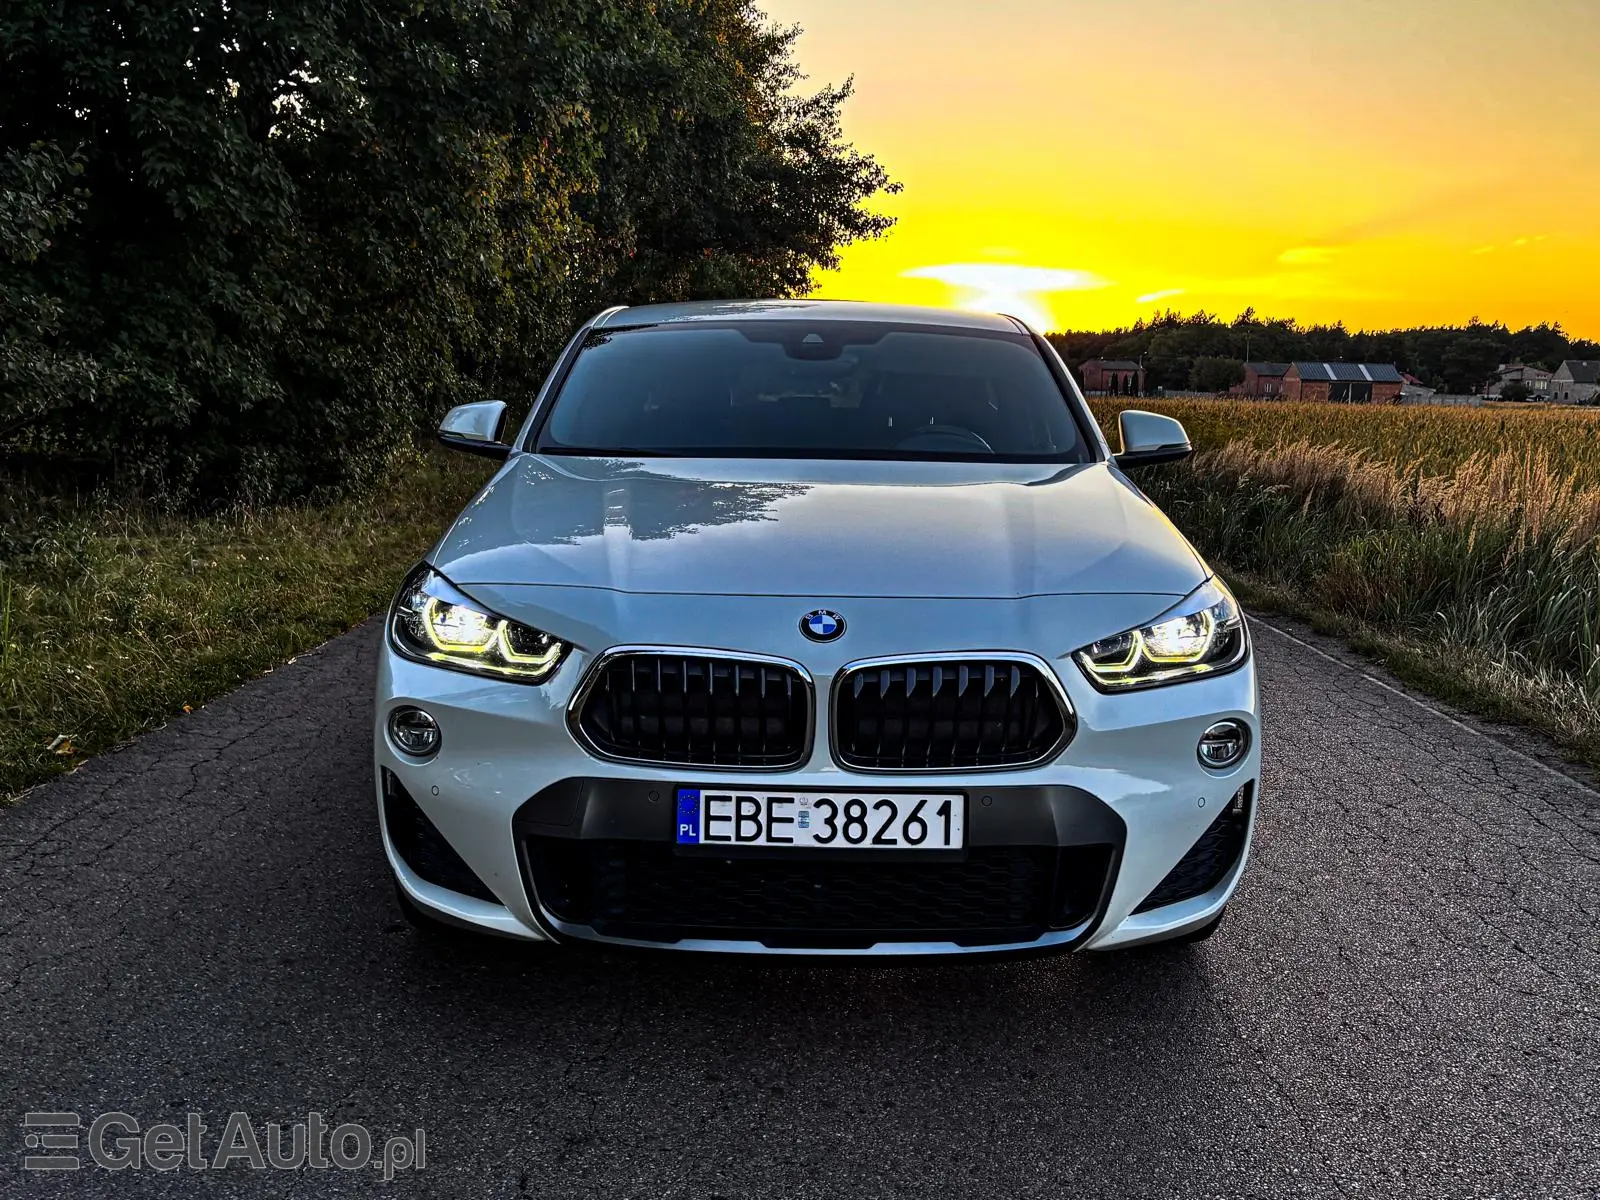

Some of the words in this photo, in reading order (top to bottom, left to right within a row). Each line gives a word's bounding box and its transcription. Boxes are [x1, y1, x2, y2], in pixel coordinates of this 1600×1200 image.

[805, 610, 841, 620] BMW
[704, 795, 795, 844] EBE
[812, 799, 952, 846] 38261
[680, 824, 696, 836] PL
